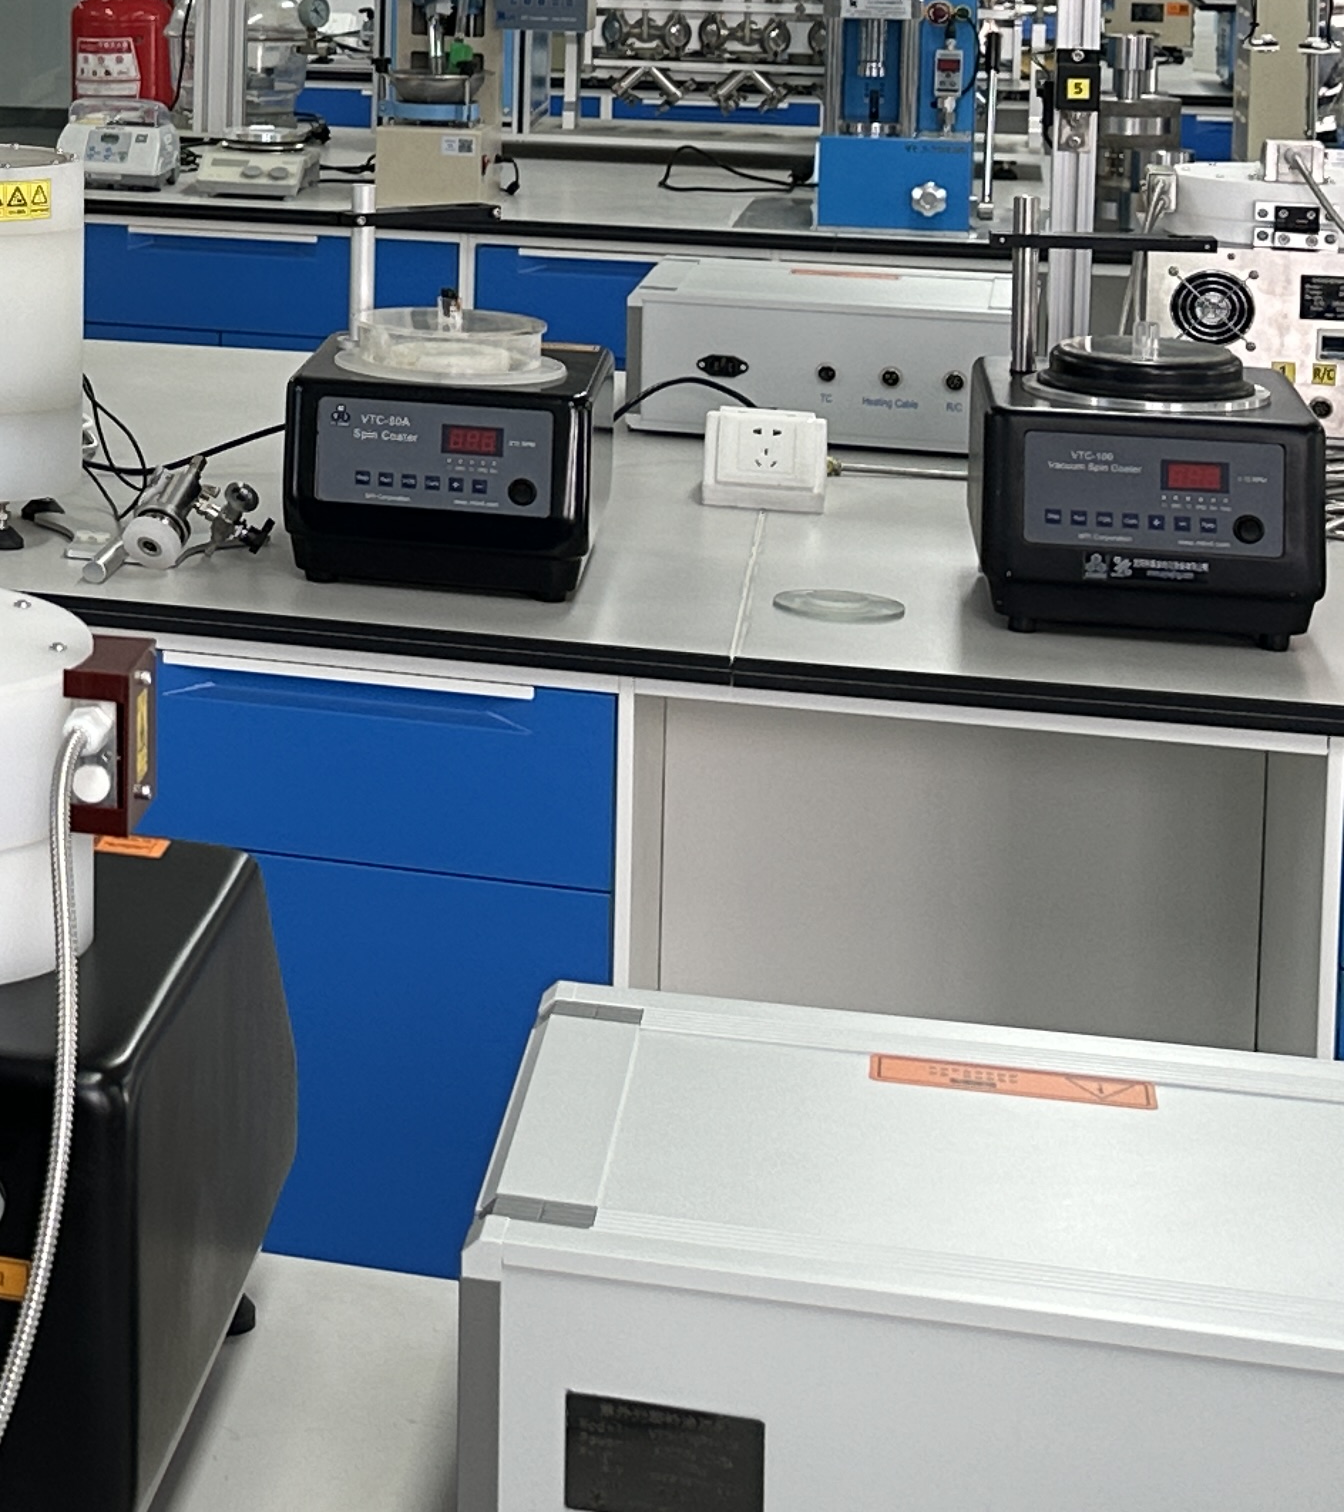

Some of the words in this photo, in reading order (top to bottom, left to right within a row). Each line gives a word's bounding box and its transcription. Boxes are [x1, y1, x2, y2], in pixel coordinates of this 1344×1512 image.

[1074, 82, 1083, 95] 5
[1313, 367, 1335, 383] R/C
[820, 392, 833, 404] TC
[862, 397, 893, 410] Heating
